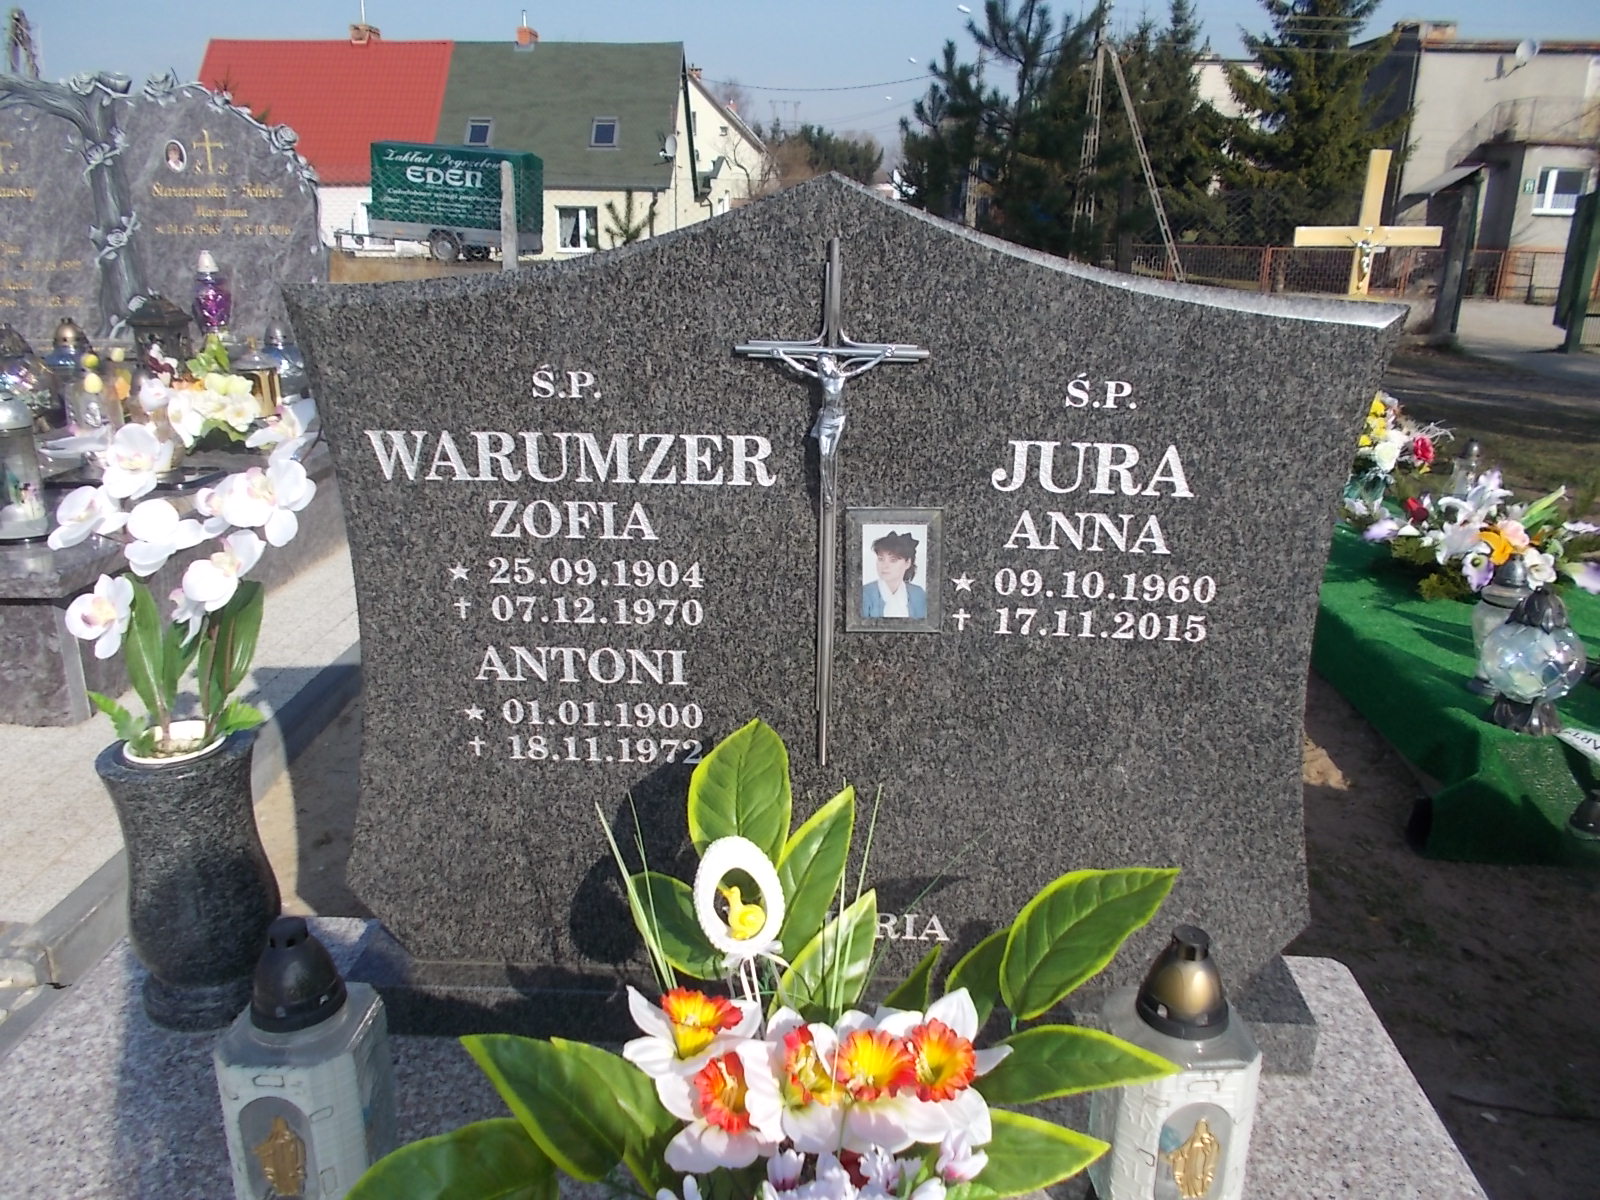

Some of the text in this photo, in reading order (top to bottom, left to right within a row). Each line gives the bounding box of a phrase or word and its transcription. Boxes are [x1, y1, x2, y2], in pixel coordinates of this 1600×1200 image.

[383, 148, 501, 170] Zakład Pogrzebow
[406, 165, 483, 188] EDEN
[532, 364, 602, 399] Ś.P.
[1064, 372, 1137, 410] Ś.P.
[363, 429, 777, 487] WARUMZER
[991, 439, 1194, 498] JURA
[488, 499, 659, 541] ZOFIA
[1003, 510, 1171, 555] ANNA
[488, 556, 704, 589] 25.09.1904
[994, 567, 1217, 604] 09.10.1960
[491, 594, 704, 626] 07.12.1970
[994, 607, 1207, 643] 17.11.2015
[475, 645, 688, 686] ANTONI
[502, 698, 704, 729] 01.01.1900
[508, 734, 703, 764] 18.11.1972
